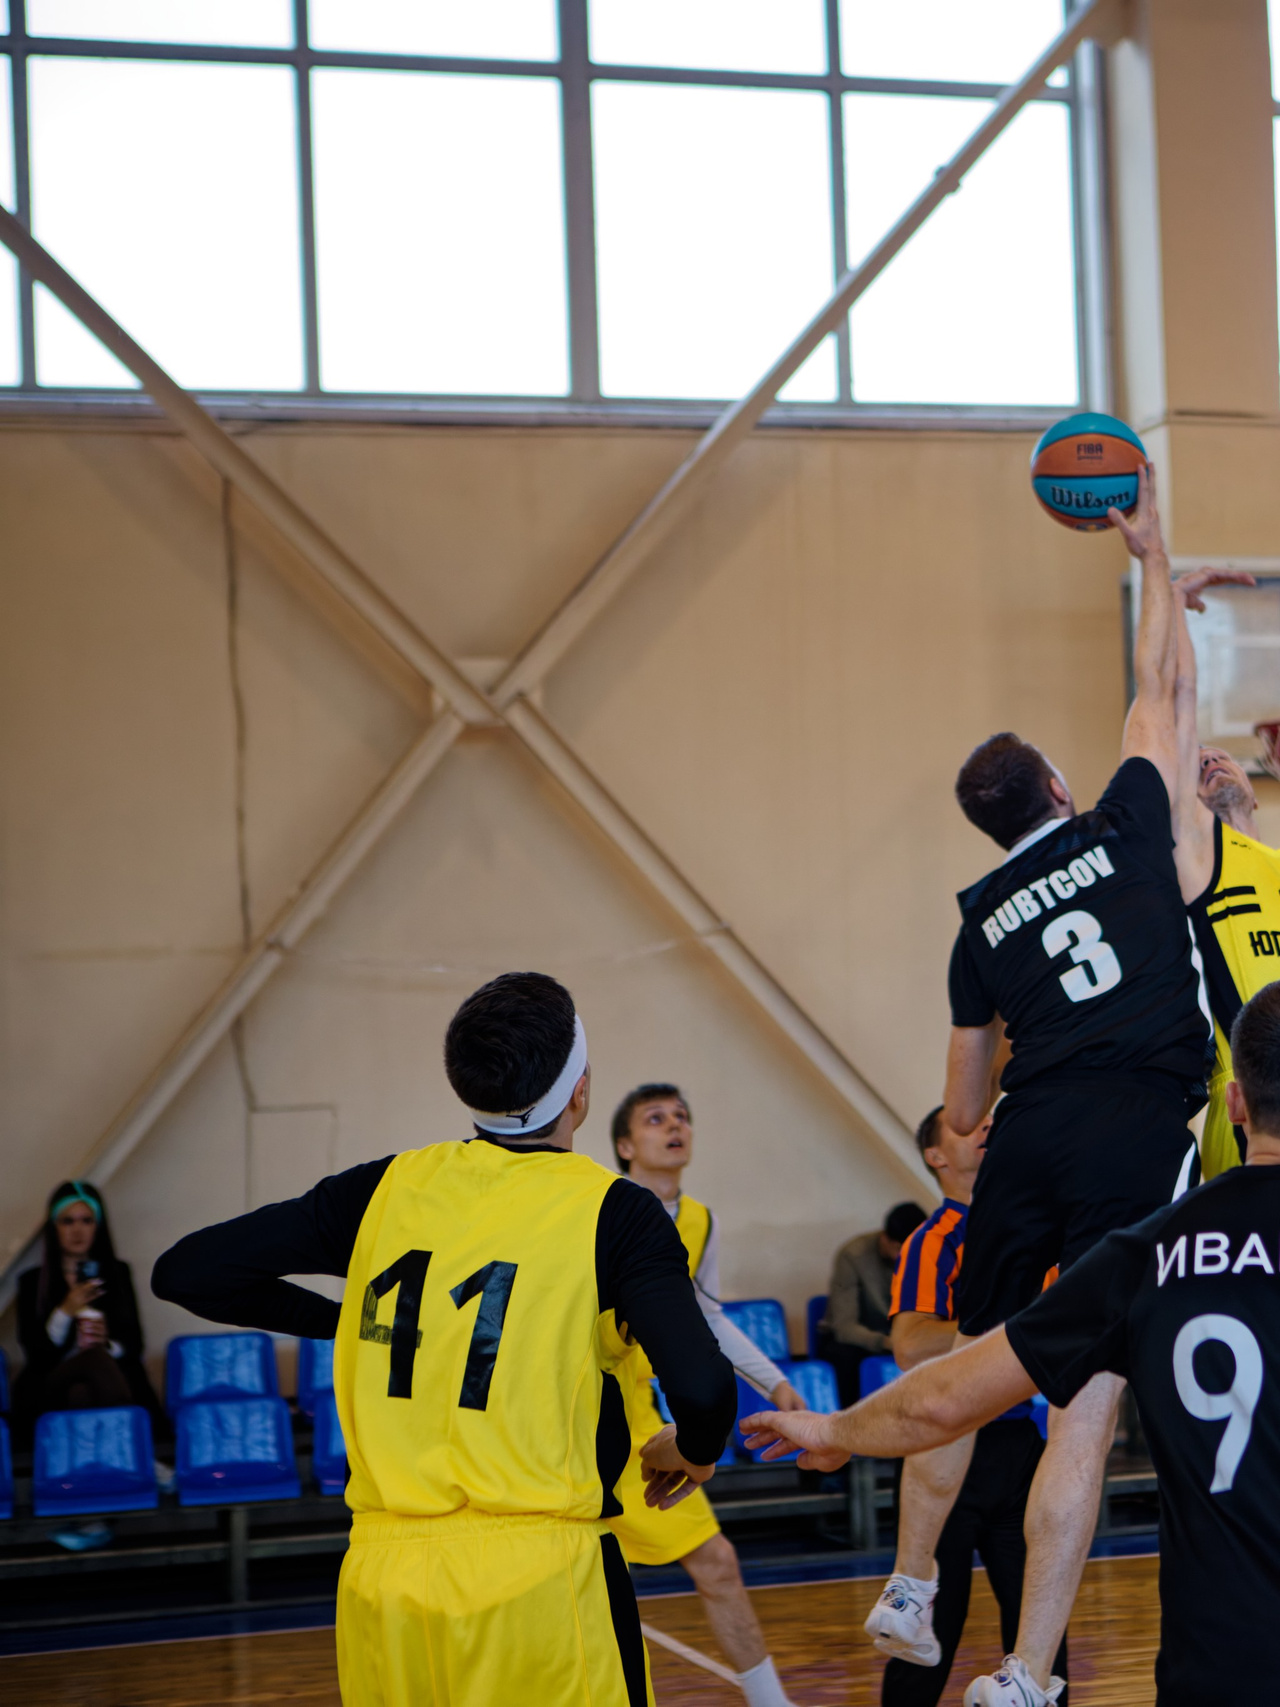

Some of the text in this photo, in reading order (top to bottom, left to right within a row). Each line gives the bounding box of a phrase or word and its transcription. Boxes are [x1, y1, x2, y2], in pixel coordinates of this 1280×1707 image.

[1076, 443, 1104, 455] FIBA
[1051, 486, 1130, 509] Wilson
[981, 845, 1116, 949] RUBTCOV
[1041, 909, 1123, 1003] 3
[358, 1248, 519, 1412] 41
